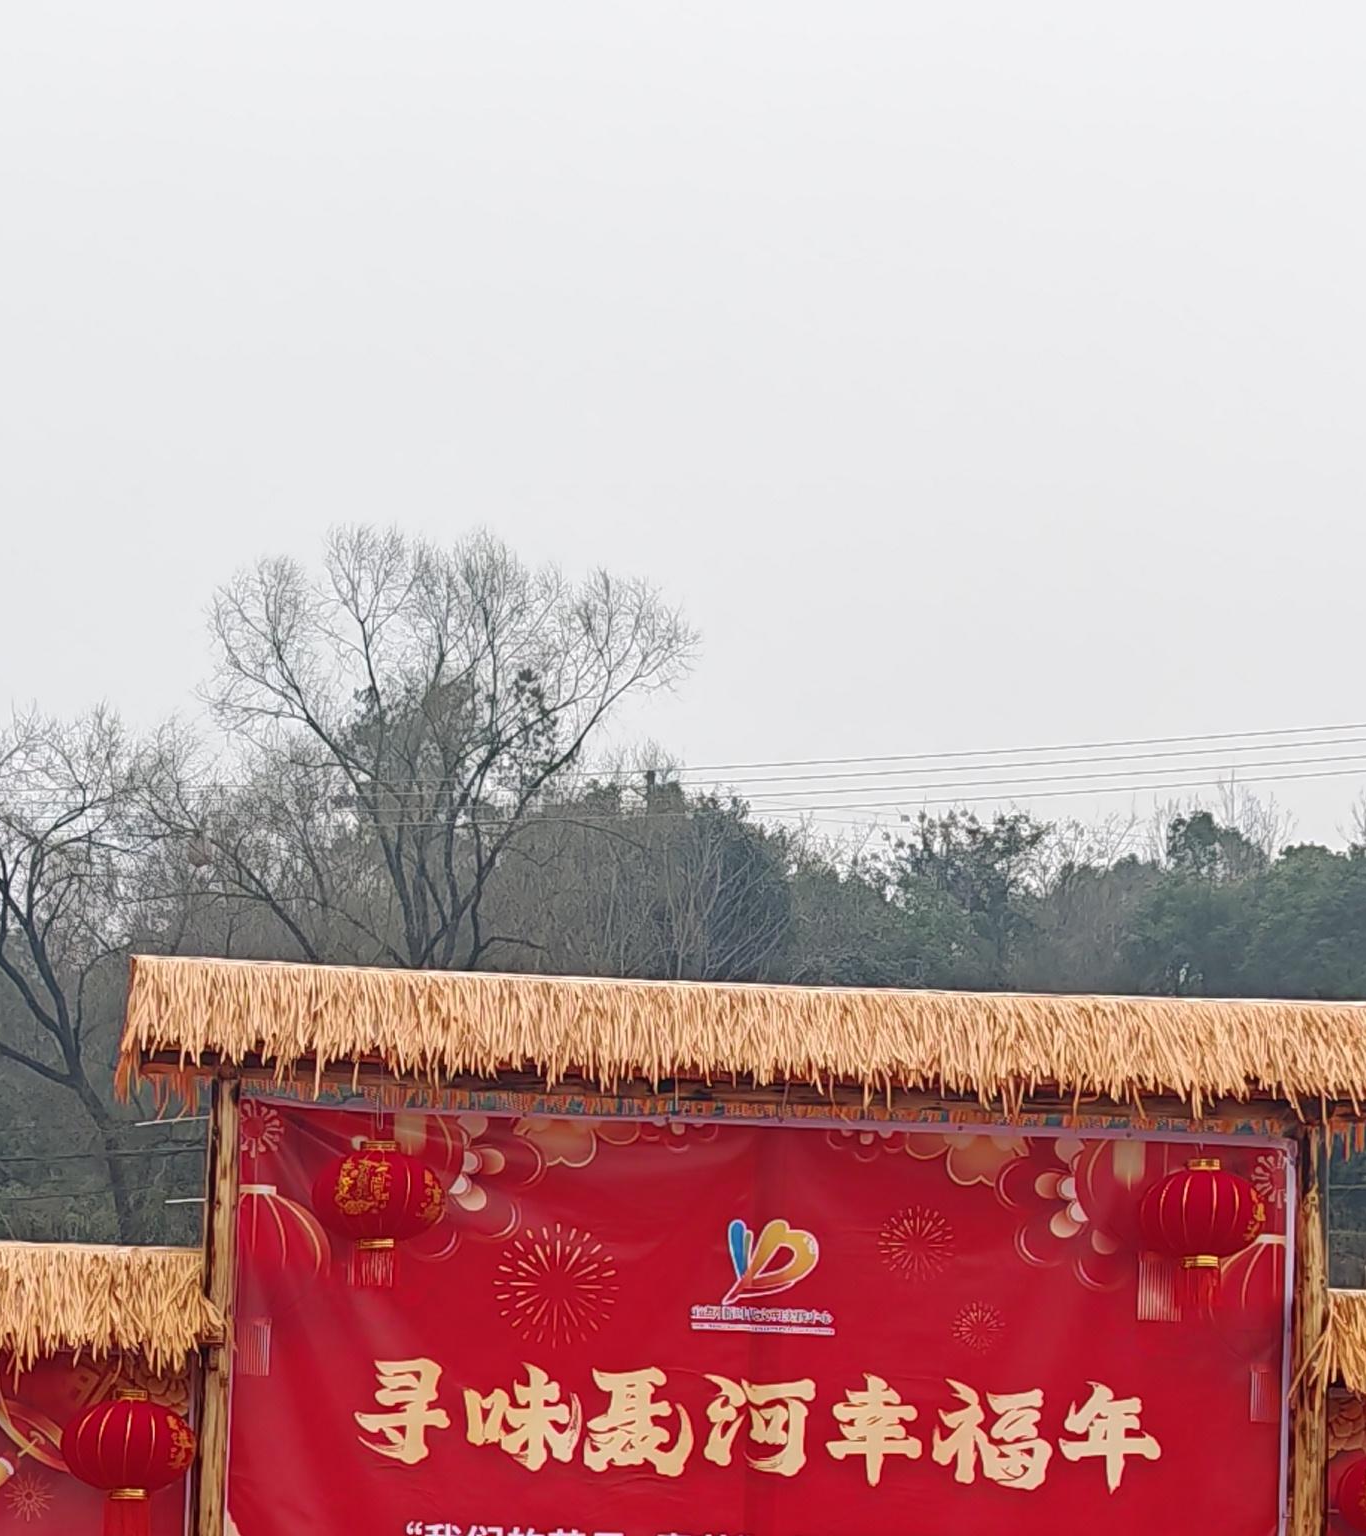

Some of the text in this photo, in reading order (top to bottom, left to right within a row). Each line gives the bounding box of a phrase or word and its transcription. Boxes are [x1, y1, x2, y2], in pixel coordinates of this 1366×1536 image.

[354, 1358, 1163, 1494] 寻味聂河幸福年
